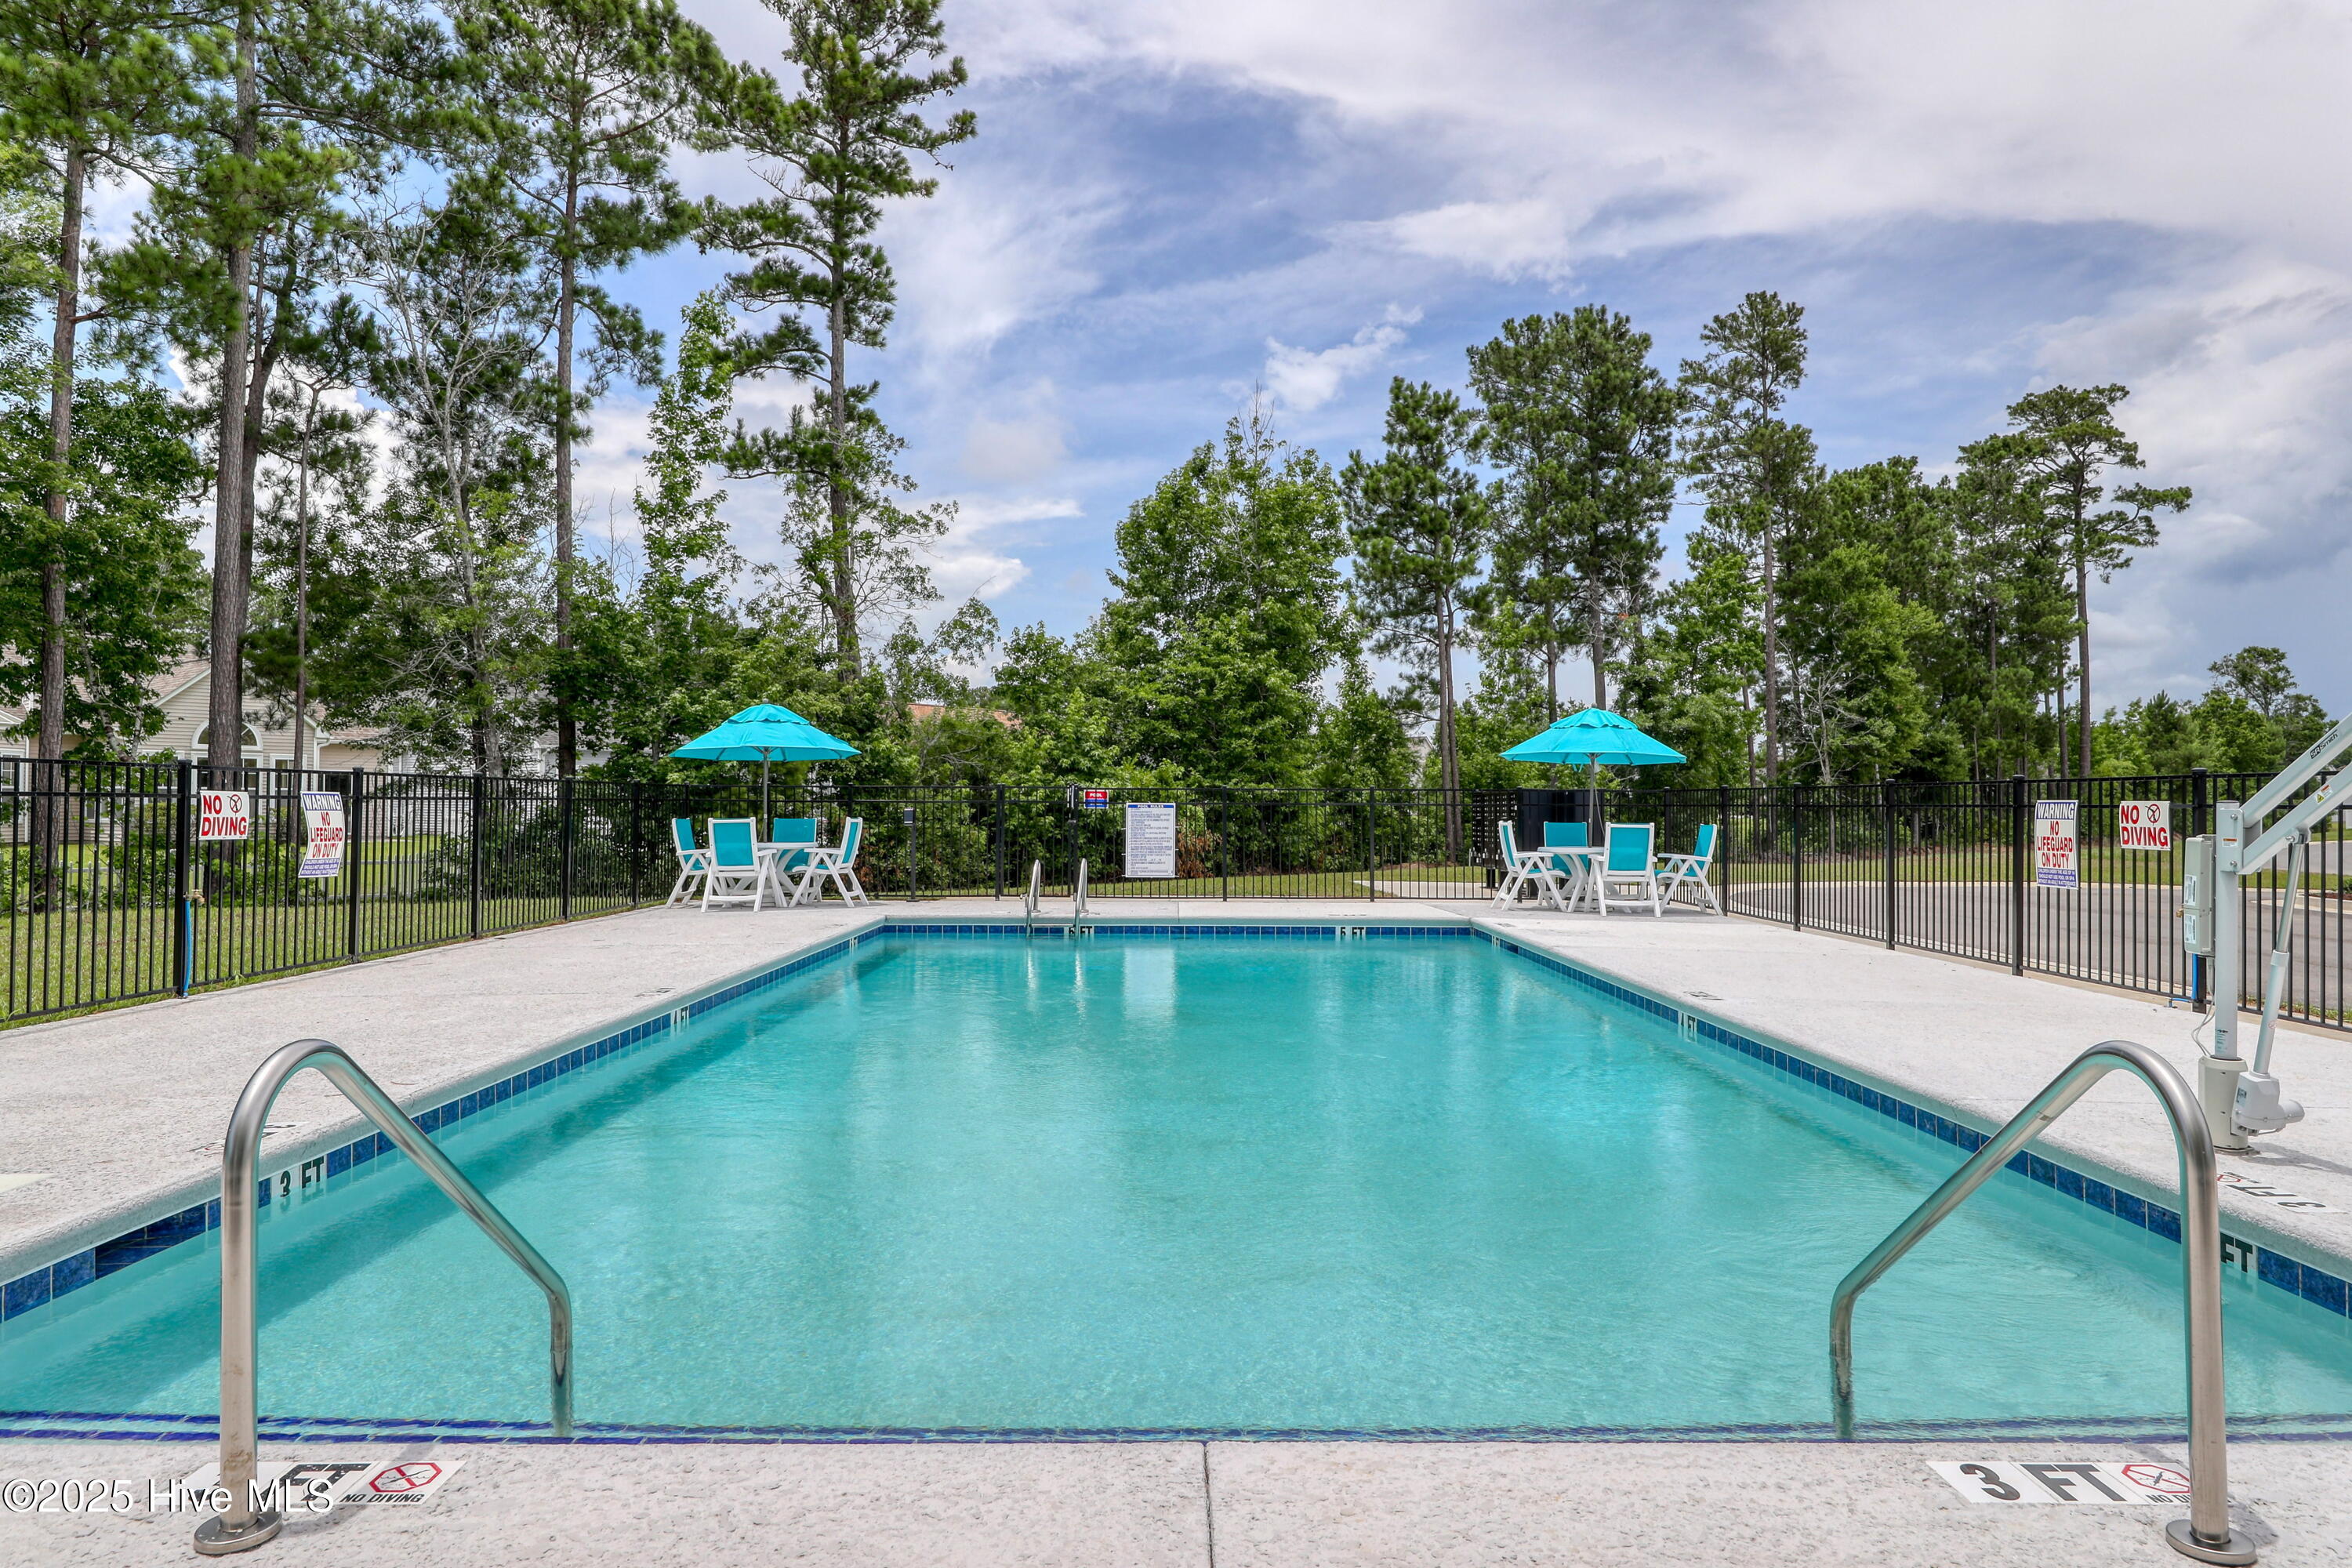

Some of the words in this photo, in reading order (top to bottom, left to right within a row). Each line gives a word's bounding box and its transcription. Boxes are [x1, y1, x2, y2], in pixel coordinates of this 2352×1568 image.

[202, 794, 223, 815] NO
[303, 794, 341, 811] WARNING
[321, 811, 331, 826] NO
[2038, 804, 2074, 819] WARNING
[2121, 805, 2140, 824] NO
[201, 816, 247, 837] DIVING
[2050, 821, 2060, 836] NO
[310, 827, 343, 843] LIFEGUARD
[2121, 826, 2169, 847] DIVING
[312, 843, 322, 858] ON
[322, 843, 339, 858] DUTY
[2038, 837, 2073, 852] LIFEGUARD
[2042, 853, 2051, 867] ON
[2052, 854, 2070, 868] DUTY
[1352, 927, 1364, 936] FT
[280, 1171, 291, 1197] 3
[302, 1156, 324, 1189] FT
[2220, 1232, 2253, 1273] FT
[1960, 1464, 2020, 1501] 3
[2020, 1464, 2127, 1501] FT
[2145, 1494, 2174, 1503] NO
[339, 1494, 366, 1503] NO
[366, 1494, 425, 1503] DIVING
